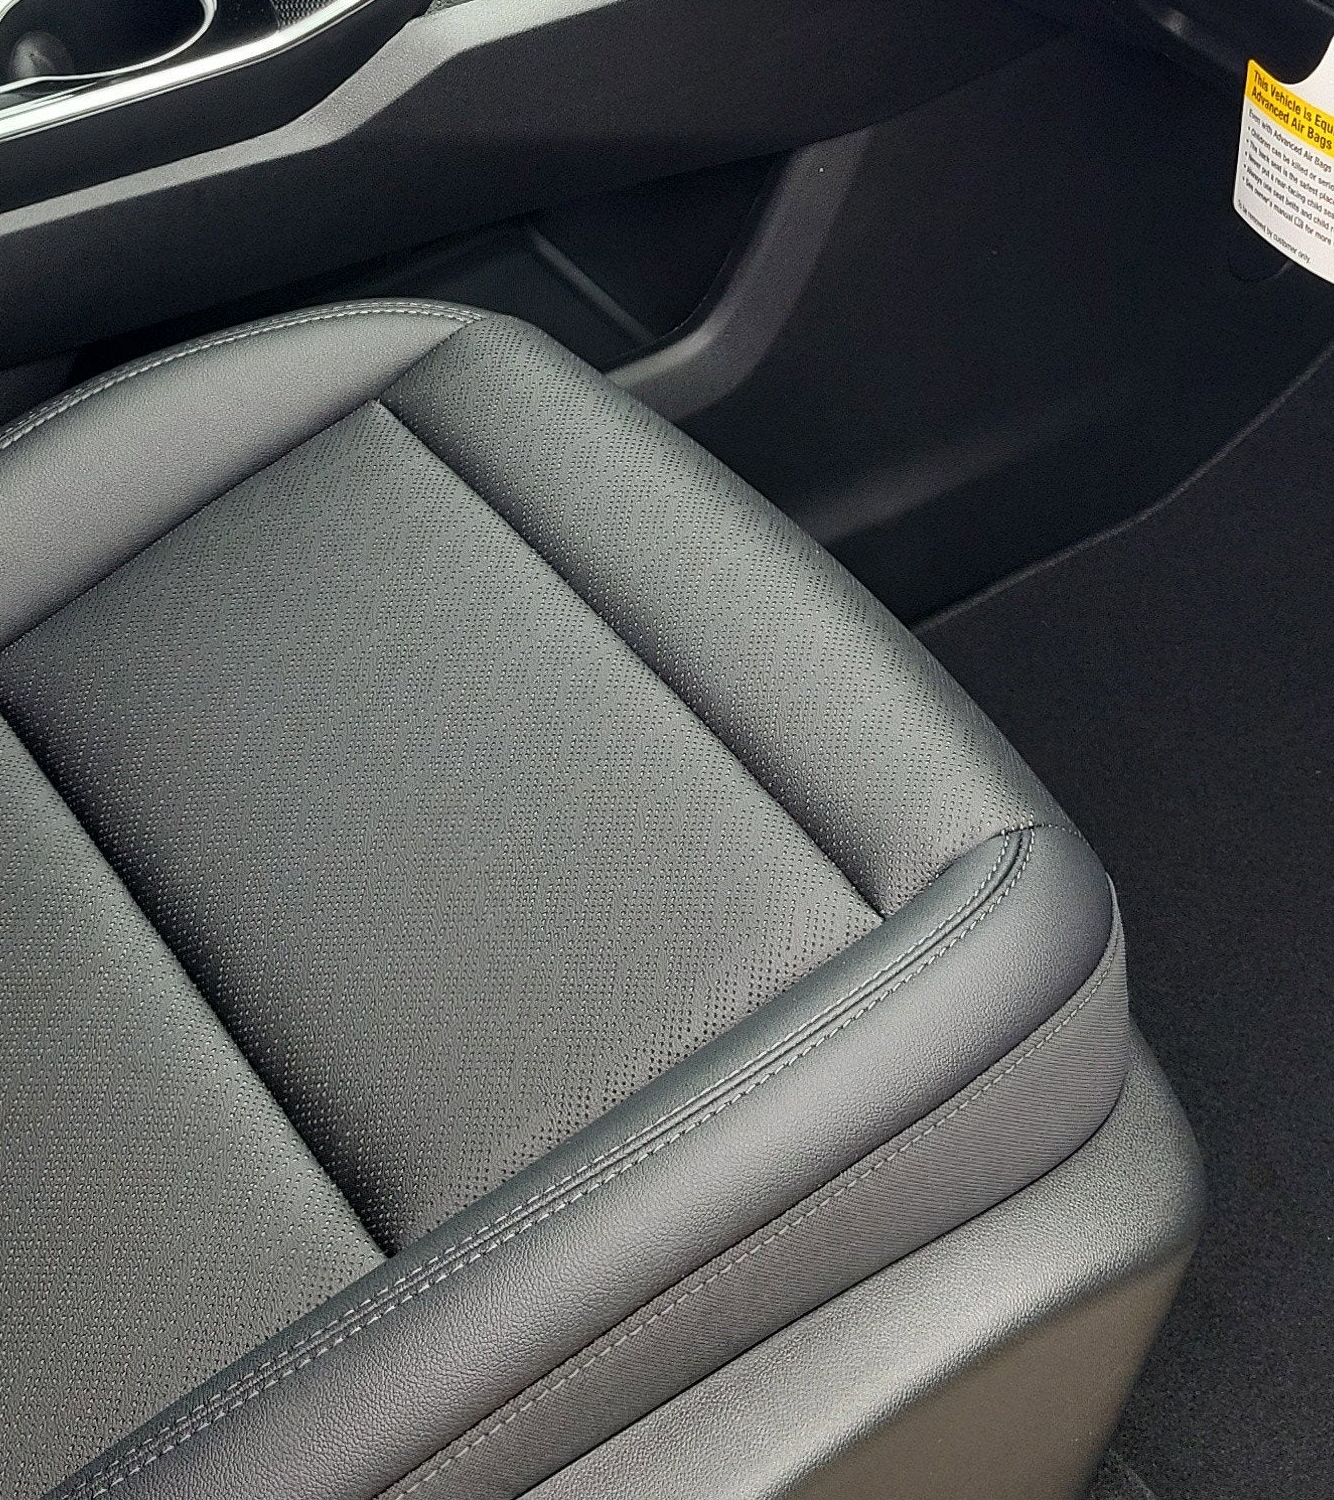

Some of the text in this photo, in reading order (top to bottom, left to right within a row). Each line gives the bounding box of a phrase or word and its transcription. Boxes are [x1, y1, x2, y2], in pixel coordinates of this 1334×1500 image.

[1254, 70, 1269, 92] This
[1270, 85, 1301, 115] Vehicle
[1303, 107, 1312, 122] is
[1251, 86, 1332, 150] Advanced Air Bags
[1251, 128, 1271, 150] Children
[1271, 147, 1282, 158] can
[1283, 153, 1290, 164] be
[1291, 159, 1308, 176] killed
[1309, 172, 1317, 181] or
[1262, 122, 1273, 135] with
[1273, 130, 1303, 155] Advanced
[1304, 150, 1313, 162] Air
[1314, 156, 1332, 173] Bags
[1289, 172, 1298, 184] the
[1299, 180, 1318, 196] safest
[1273, 204, 1293, 222] manual
[1305, 224, 1314, 234] for
[1315, 231, 1332, 245] more
[1301, 209, 1312, 220] and
[1313, 216, 1330, 230] child
[1307, 199, 1323, 212] child
[1273, 233, 1298, 255] customer
